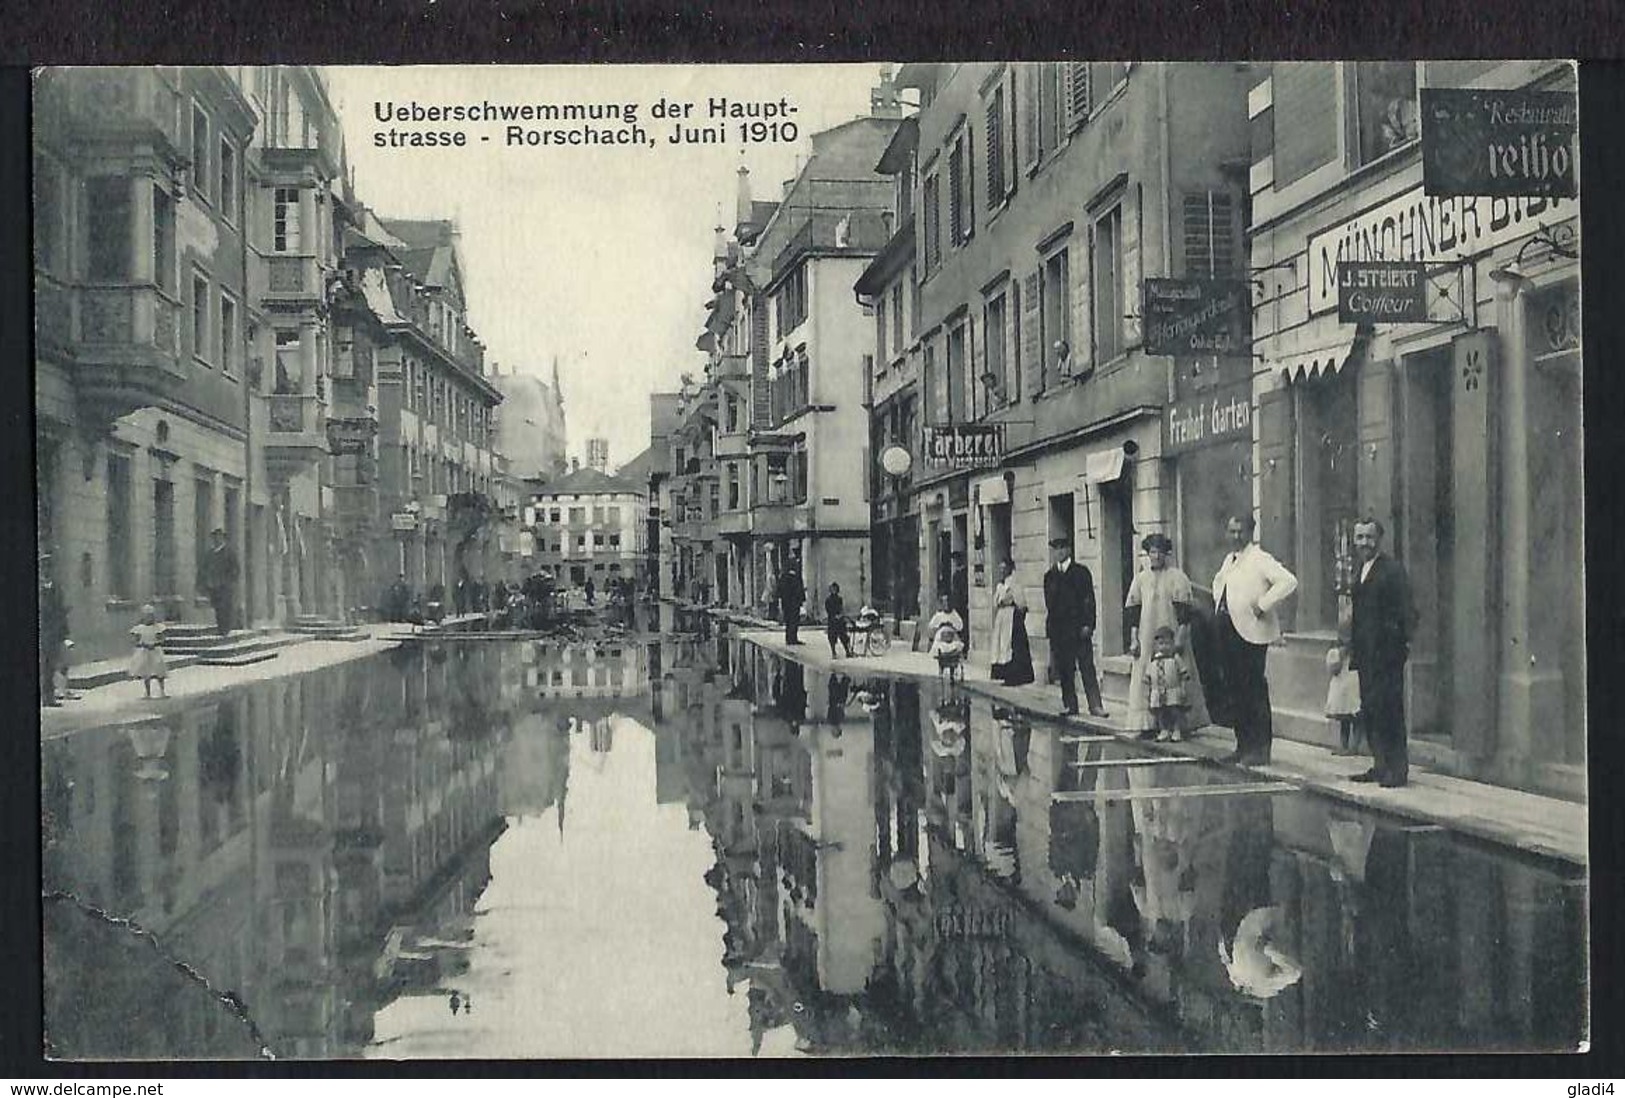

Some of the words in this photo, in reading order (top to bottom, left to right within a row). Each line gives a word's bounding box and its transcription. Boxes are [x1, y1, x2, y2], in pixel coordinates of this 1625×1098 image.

[1322, 195, 1481, 298] MÜNCHNER
[1342, 269, 1355, 287] J.
[1358, 269, 1418, 288] STEIERT
[1348, 293, 1414, 314] Coiffeur
[1211, 397, 1250, 435] Garten
[924, 426, 1000, 459] Färberei
